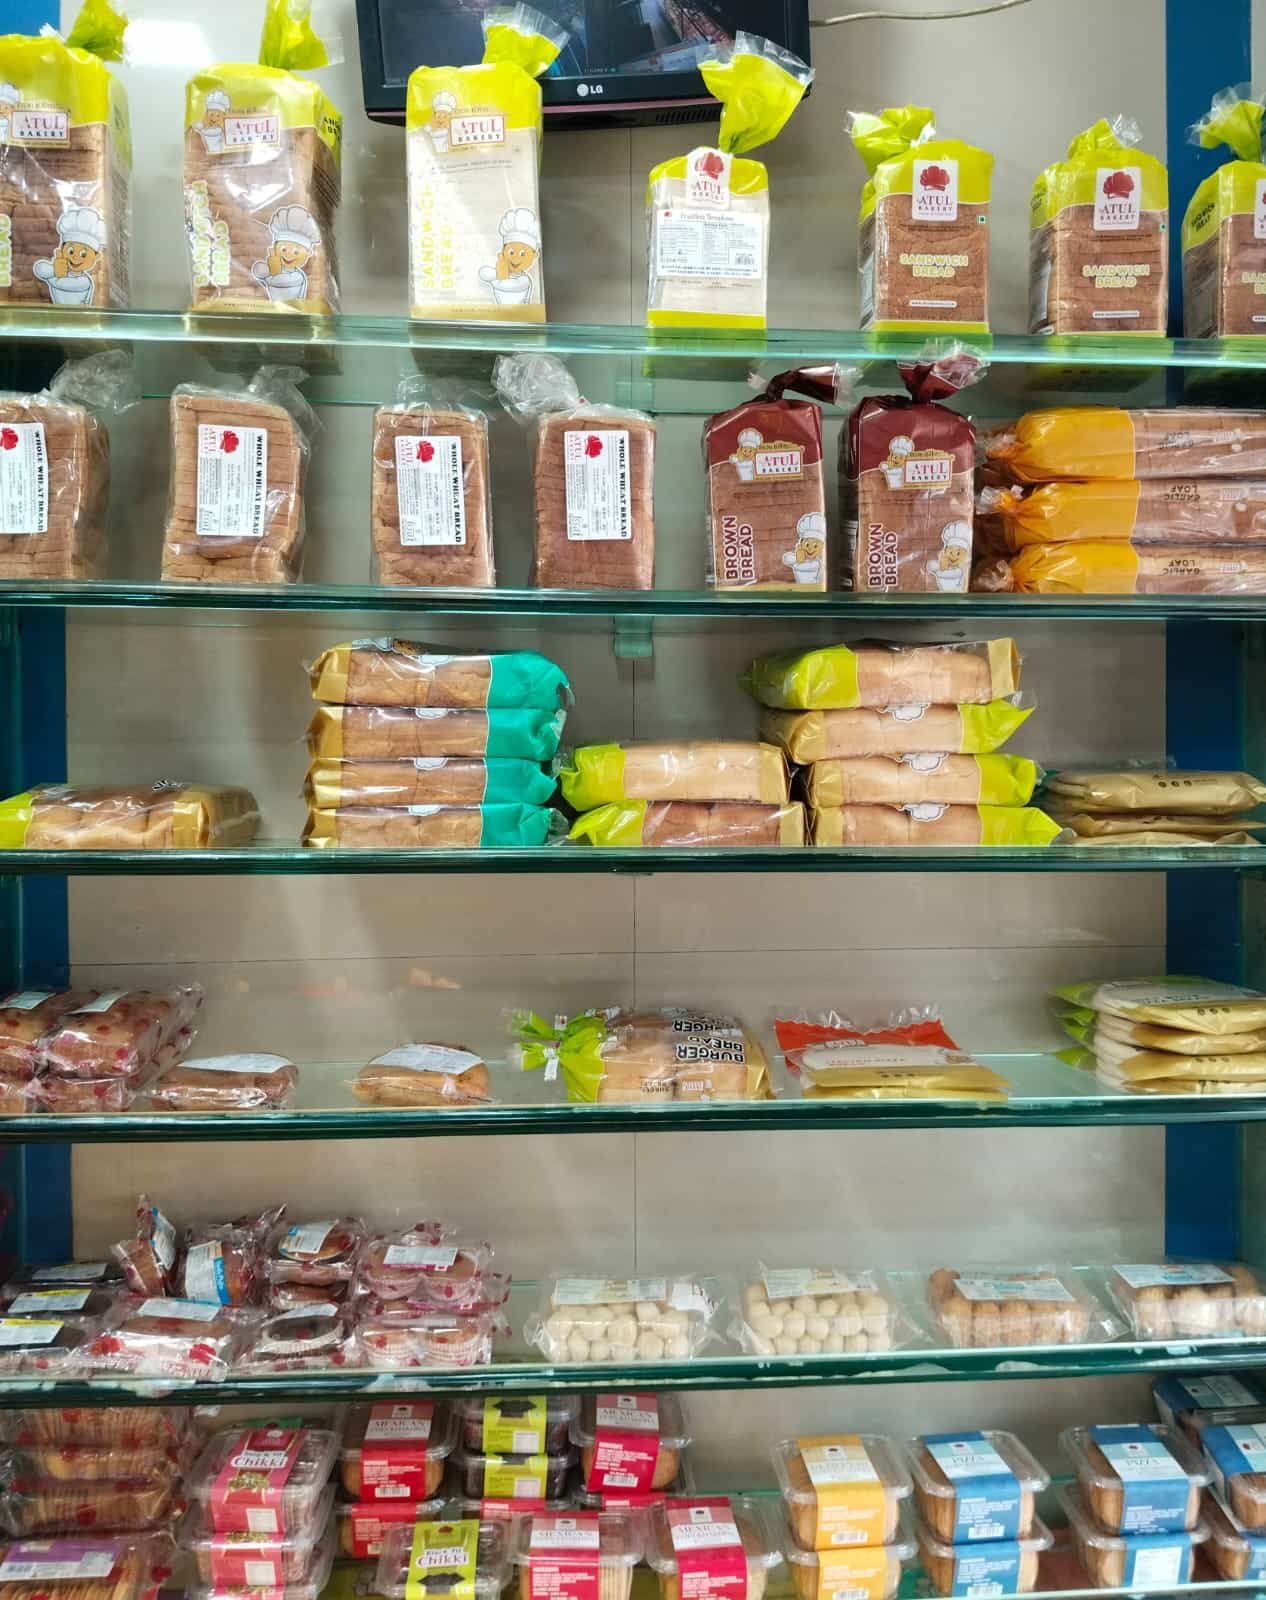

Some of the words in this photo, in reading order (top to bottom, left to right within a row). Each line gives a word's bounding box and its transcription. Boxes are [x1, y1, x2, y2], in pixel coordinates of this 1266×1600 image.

[590, 85, 603, 94] LG
[917, 195, 952, 206] ATUL
[1099, 203, 1135, 214] ATUL
[900, 254, 969, 266] SANDWICH
[913, 266, 955, 277] BREAD
[1083, 264, 1150, 277] SANDWICH
[1095, 276, 1137, 288] BREAD
[35, 431, 43, 464] WHOLE
[618, 438, 626, 470] WHOLE
[760, 453, 799, 466] ATUL
[911, 462, 947, 475] ATUL
[254, 470, 262, 502] WHEAT
[619, 472, 627, 504] WHEAT
[1170, 485, 1198, 493] LOAF
[452, 477, 460, 509] WHEAT
[1164, 493, 1200, 501] GARLIC
[454, 511, 462, 543] BREAD
[620, 506, 628, 537] BREAD
[723, 516, 738, 580] BROWN
[739, 525, 754, 579] BREAD
[869, 524, 882, 586] BROWN
[885, 533, 897, 586] BREAD
[1168, 559, 1196, 567] LOAF
[1163, 567, 1200, 575] GARLIC
[677, 1043, 745, 1063] BURGER
[234, 1456, 284, 1467] Chikki
[418, 1554, 467, 1566] Chikki
